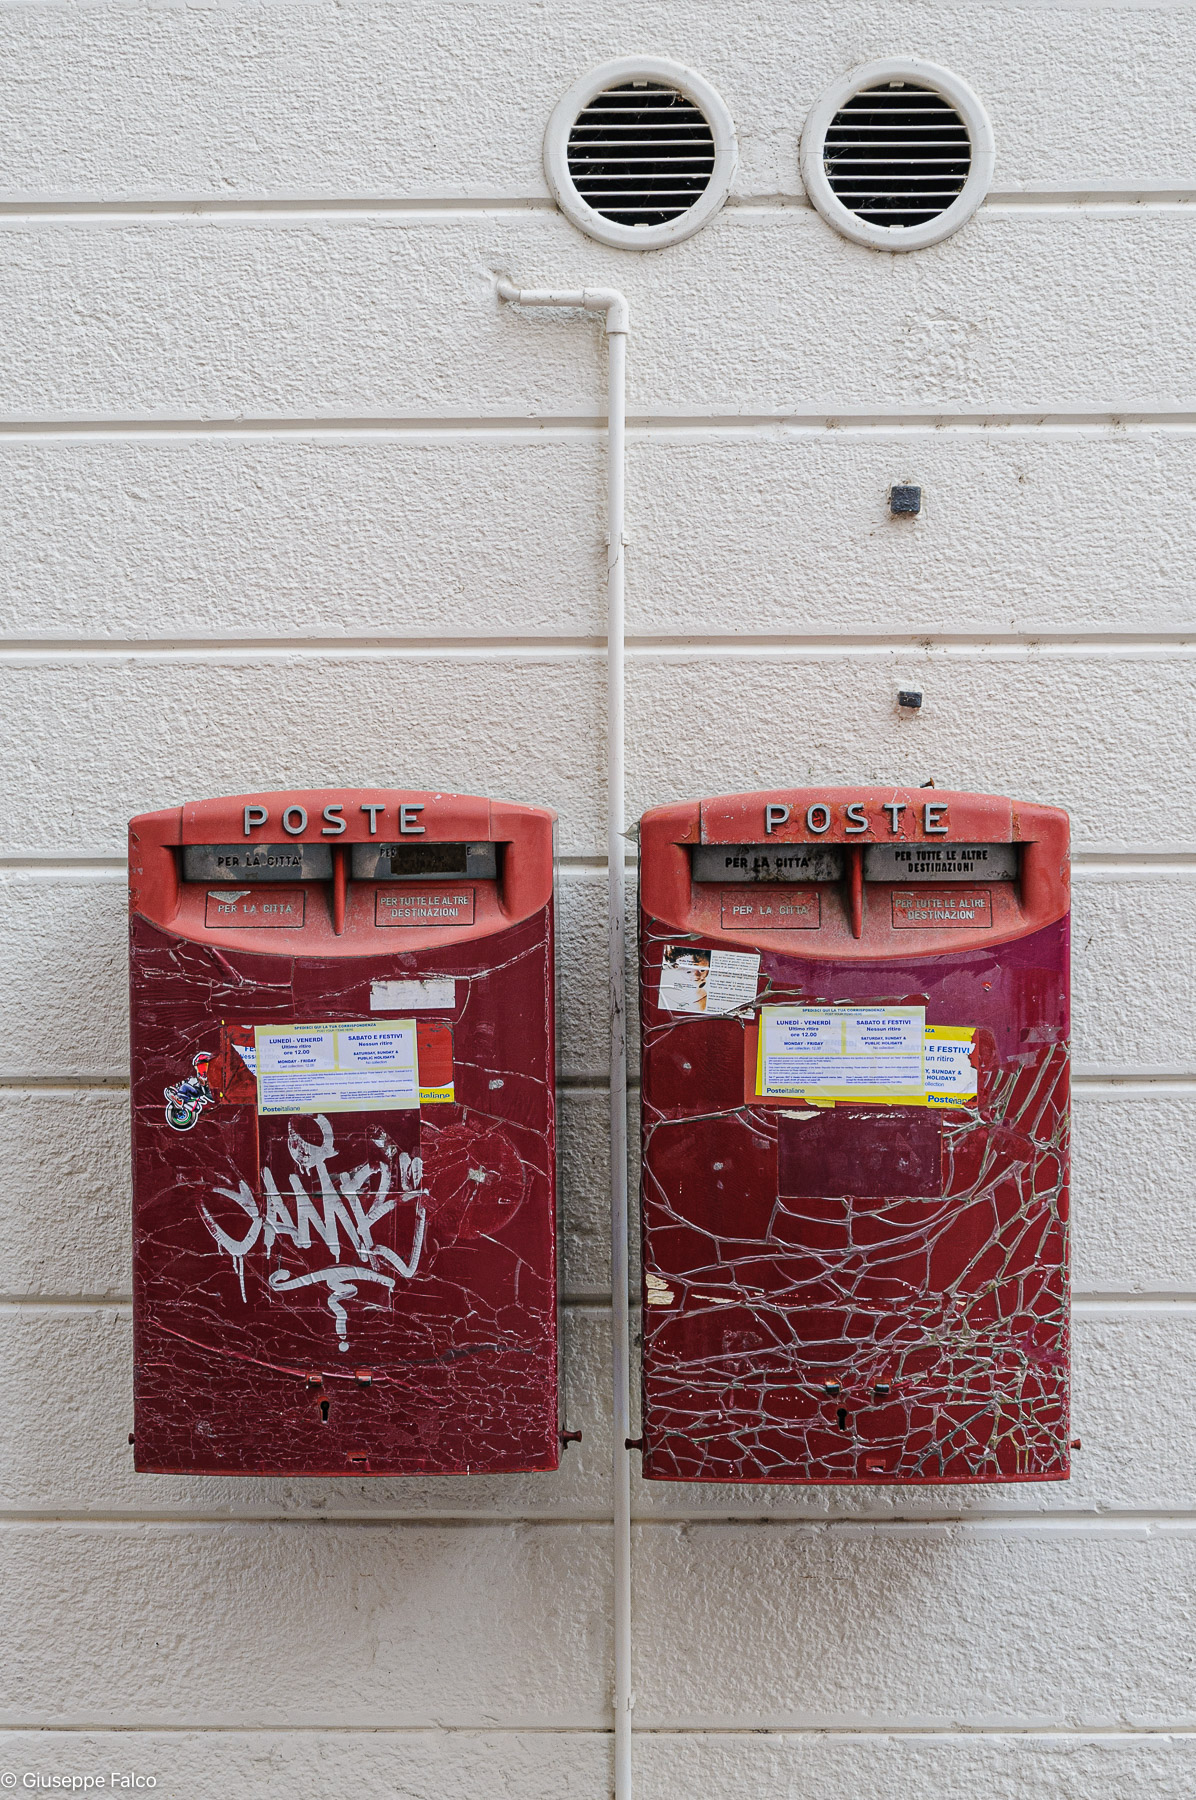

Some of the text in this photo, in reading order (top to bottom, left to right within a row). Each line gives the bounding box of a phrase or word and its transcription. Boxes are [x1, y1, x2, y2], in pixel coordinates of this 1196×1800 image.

[244, 804, 425, 835] POSTE
[766, 803, 948, 834] POSTE
[895, 850, 988, 861] PER TUTTE LE ALTRE
[218, 857, 239, 867] PER
[246, 857, 260, 866] LA
[725, 857, 748, 868] PER
[754, 857, 770, 867] LA
[908, 862, 974, 872] DESTINAZIONI
[380, 896, 469, 906] PER TUTTE LE ALTRE
[895, 899, 986, 908] PER TUTTE LE ALTRE
[218, 904, 237, 913] PER
[244, 904, 256, 913] LA
[391, 908, 459, 917] DESTINAZIONI
[732, 906, 753, 915] PER
[759, 906, 772, 915] LA
[937, 1046, 970, 1054] FESTIVI
[262, 1105, 301, 1113] Posteitaliane
